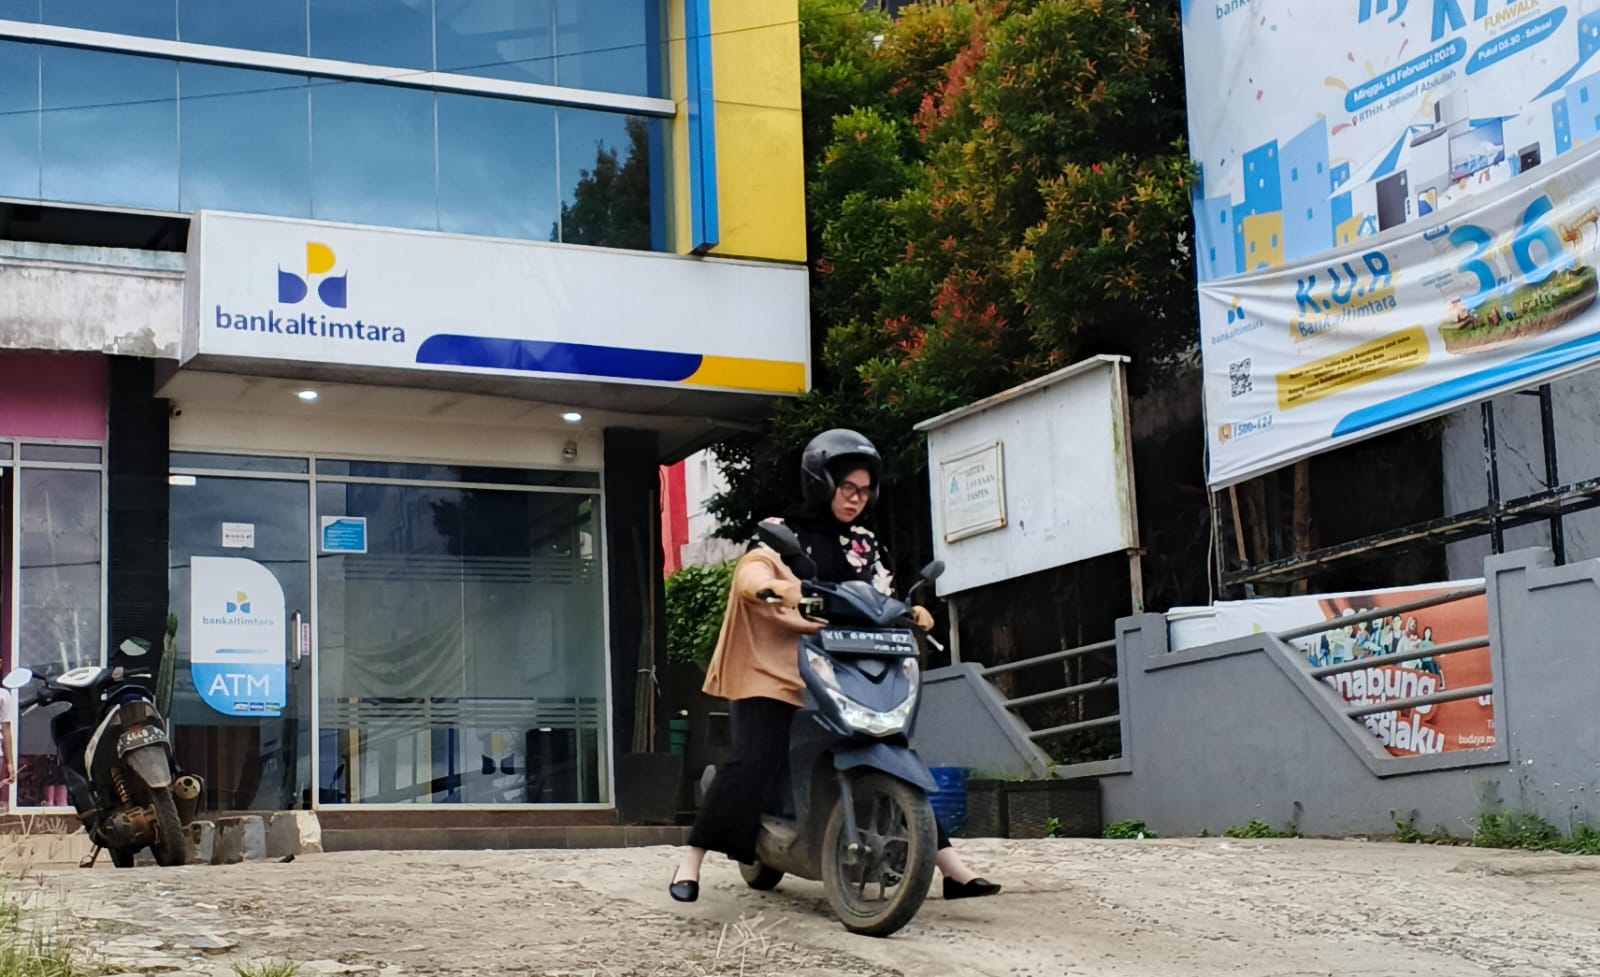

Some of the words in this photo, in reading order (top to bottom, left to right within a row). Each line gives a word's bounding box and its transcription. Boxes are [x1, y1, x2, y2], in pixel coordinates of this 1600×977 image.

[1397, 55, 1434, 80] Februari
[215, 304, 405, 343] bankaltimtara
[1212, 318, 1264, 345] bankaltimtara
[203, 615, 275, 627] bankaltimtara
[208, 673, 270, 697] ATM
